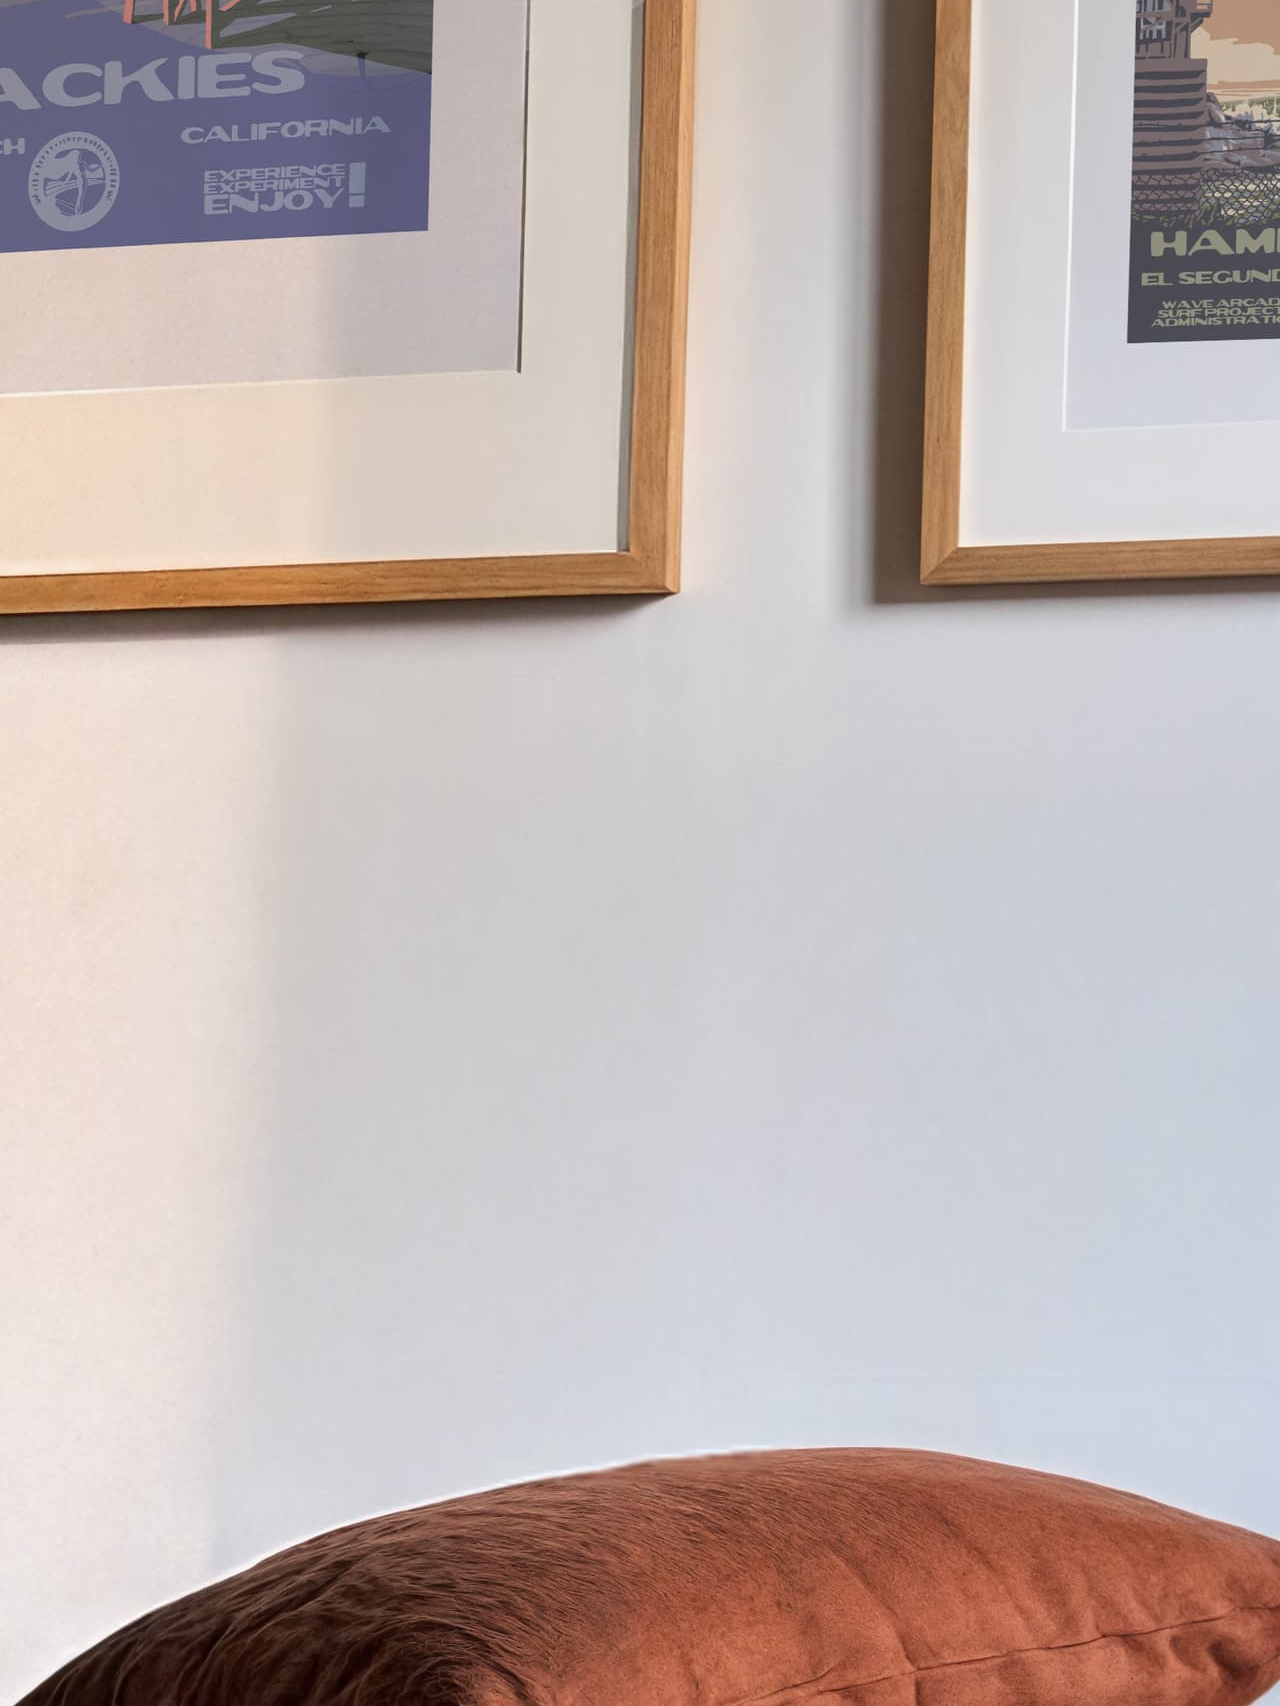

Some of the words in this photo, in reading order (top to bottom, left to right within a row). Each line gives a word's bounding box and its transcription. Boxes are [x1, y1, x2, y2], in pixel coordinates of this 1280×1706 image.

[180, 116, 392, 145] CALIFORNIA
[203, 163, 347, 183] EXPERIENCE
[203, 176, 345, 195] EXPERIMENT
[1150, 228, 1280, 257] HAM
[1141, 272, 1174, 286] EL
[1162, 300, 1214, 308] WAVE
[1151, 315, 1280, 327] ADMINISTRATI
[1158, 308, 1202, 318] SURF
